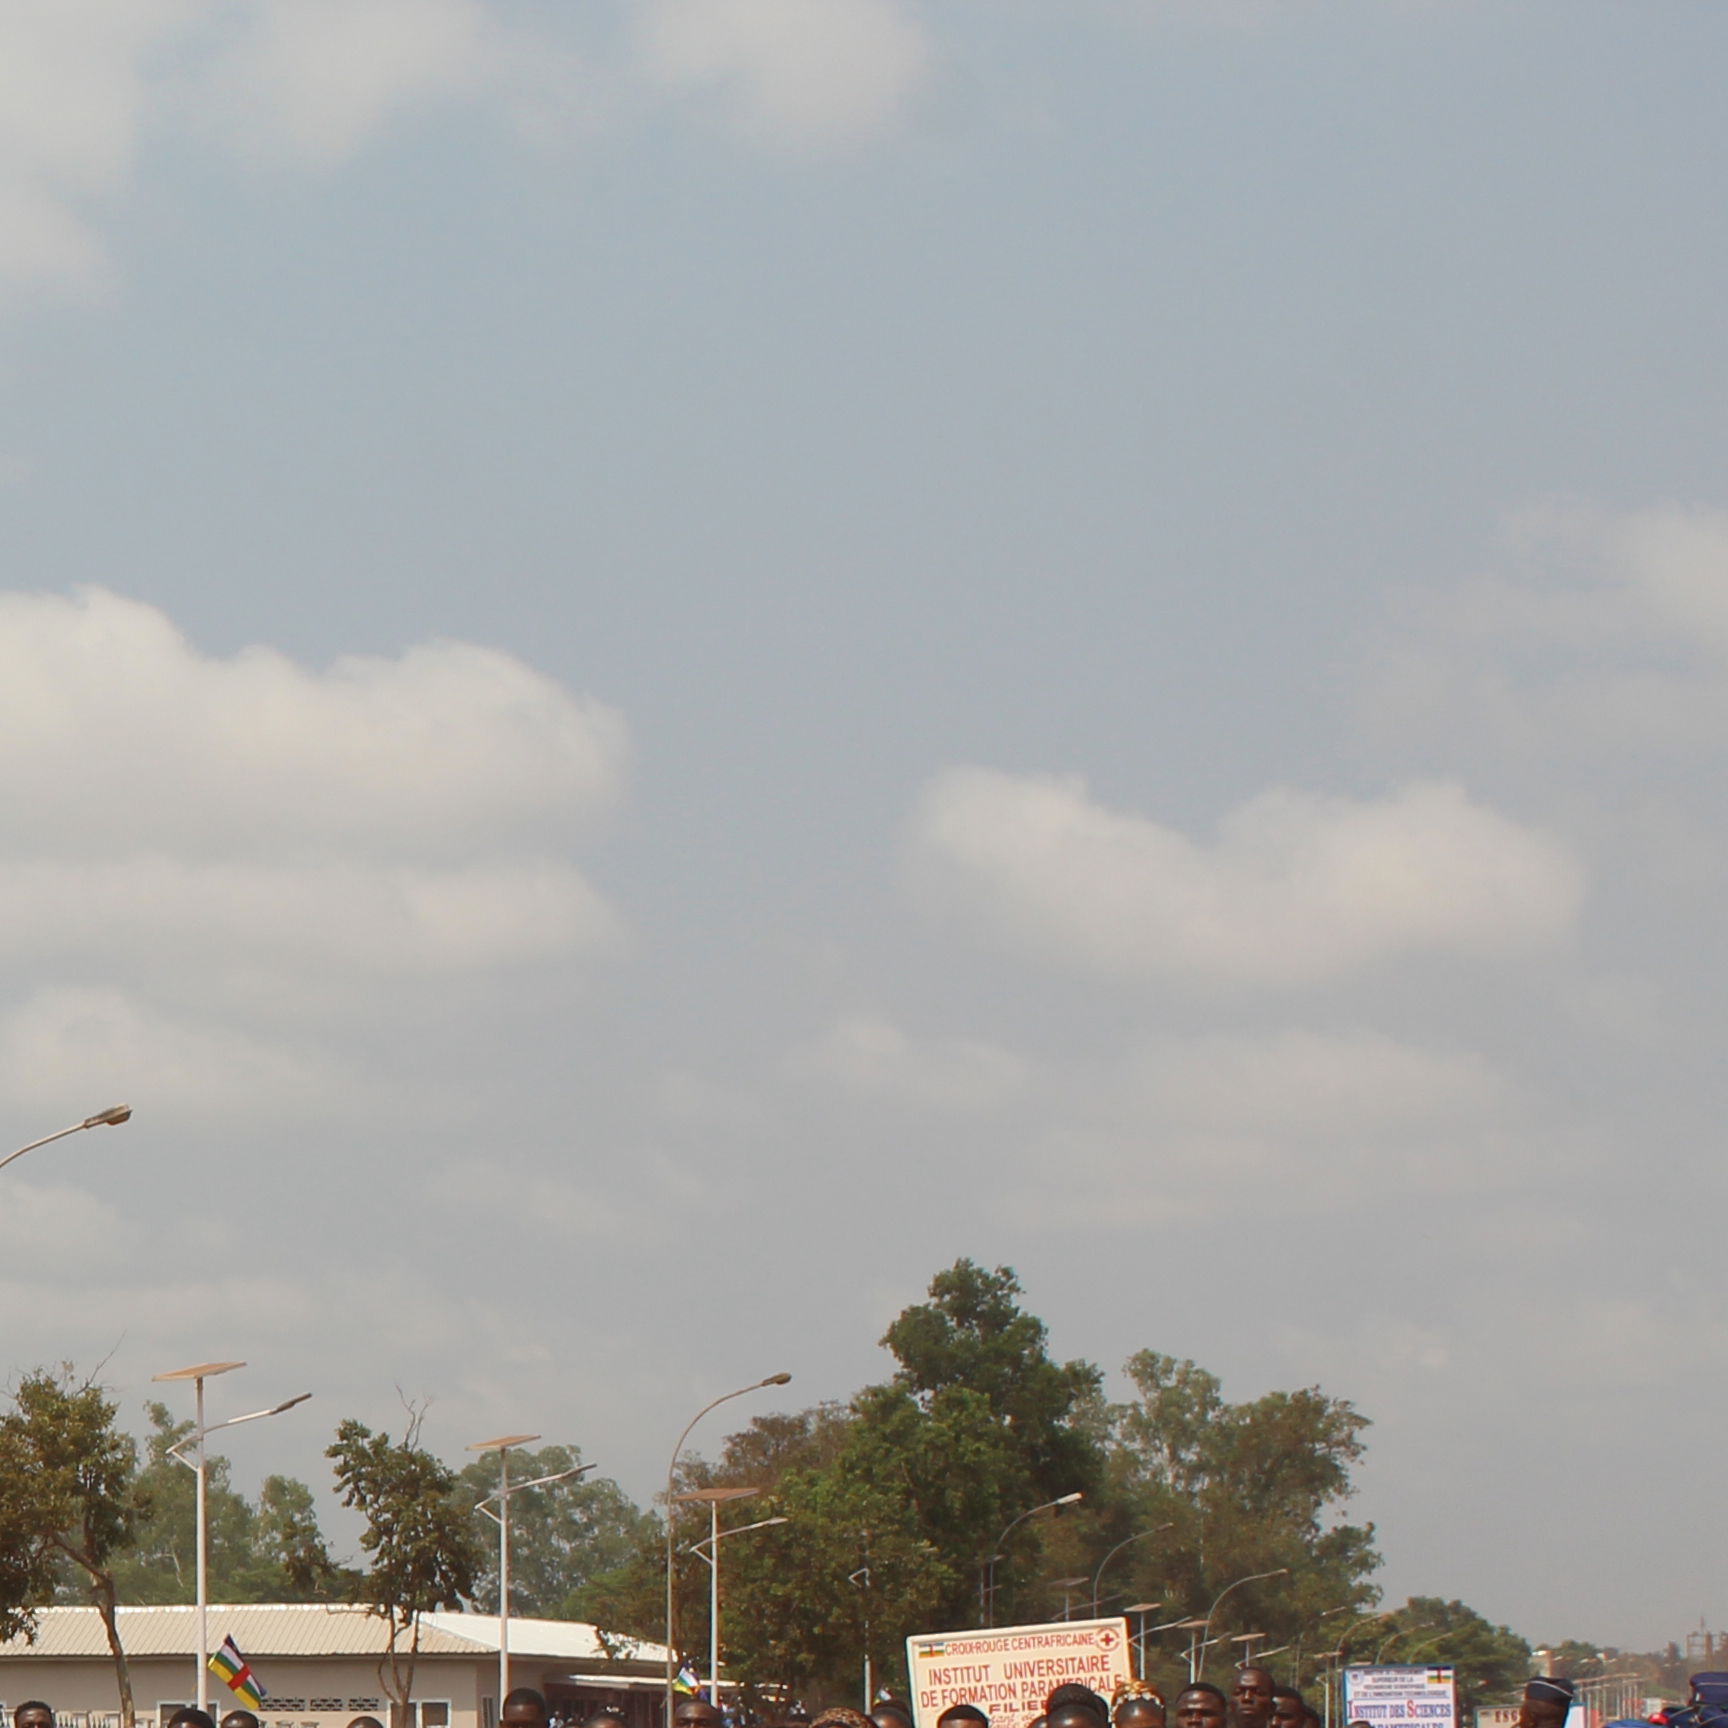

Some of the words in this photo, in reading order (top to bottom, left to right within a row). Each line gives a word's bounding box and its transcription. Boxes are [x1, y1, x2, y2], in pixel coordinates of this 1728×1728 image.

[945, 1639, 1010, 1657] CROIX-ROUGE
[1011, 1633, 1095, 1651] CENTRAFRICAINE
[929, 1664, 990, 1686] INSTITUT
[1004, 1655, 1110, 1680] UNIVERSITAIRE
[921, 1690, 938, 1708] DE
[941, 1682, 1017, 1706] FORMATION
[1347, 1700, 1387, 1718] INSTITUT
[1389, 1704, 1405, 1718] DES
[1406, 1699, 1452, 1718] SCIENCES
